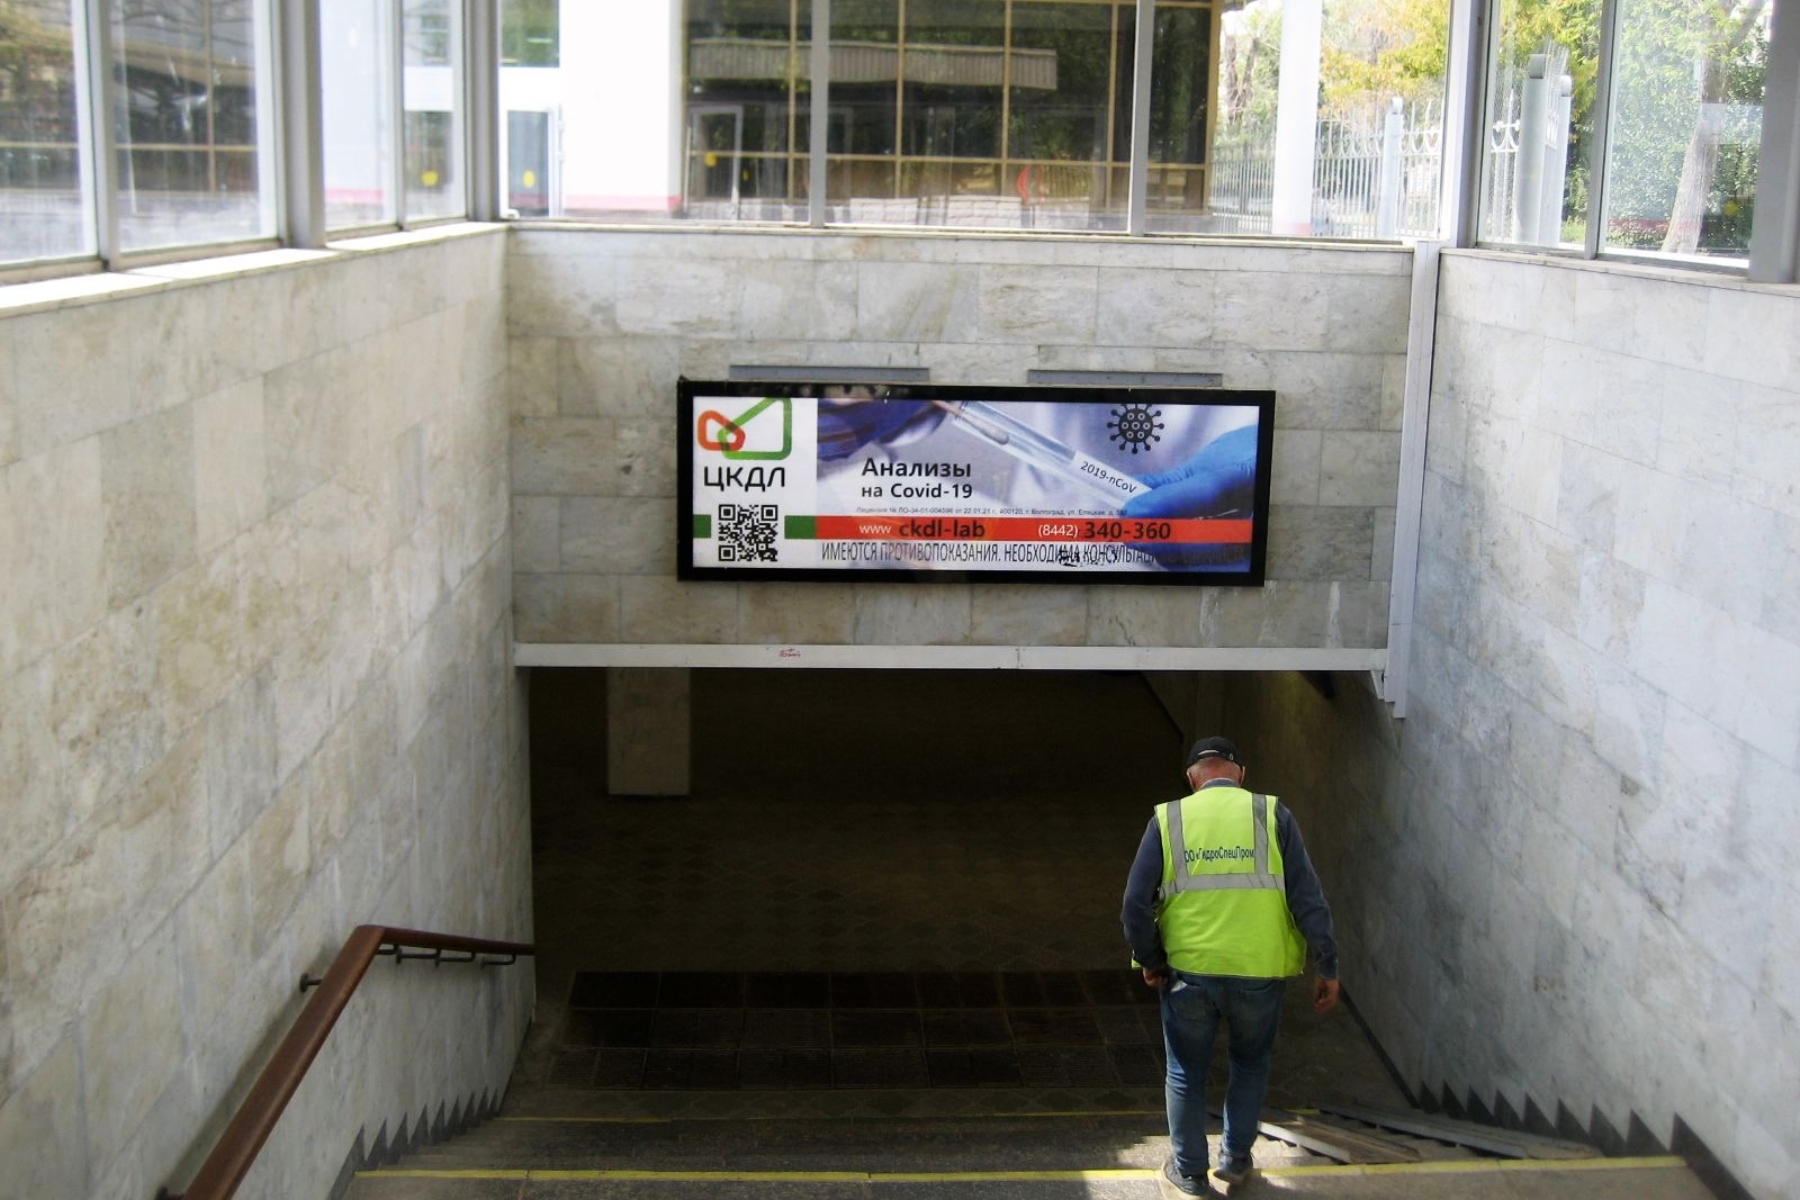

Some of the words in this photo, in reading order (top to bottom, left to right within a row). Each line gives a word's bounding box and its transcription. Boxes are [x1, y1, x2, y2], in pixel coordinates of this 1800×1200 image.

[861, 457, 972, 478] Анализы
[1080, 460, 1138, 494] 2019-nCoV
[703, 466, 786, 492] ЦКДЛ
[861, 485, 883, 498] на
[890, 482, 973, 499] Covid-19
[859, 524, 892, 534] www
[898, 519, 986, 538] ckdl-lab
[1037, 524, 1079, 538] (8442)
[1083, 521, 1172, 540] 340-360
[821, 541, 878, 562] ИМЕЮТСЯ
[879, 541, 1001, 563] ПРОТИВОПОКАЗАНИЯ.
